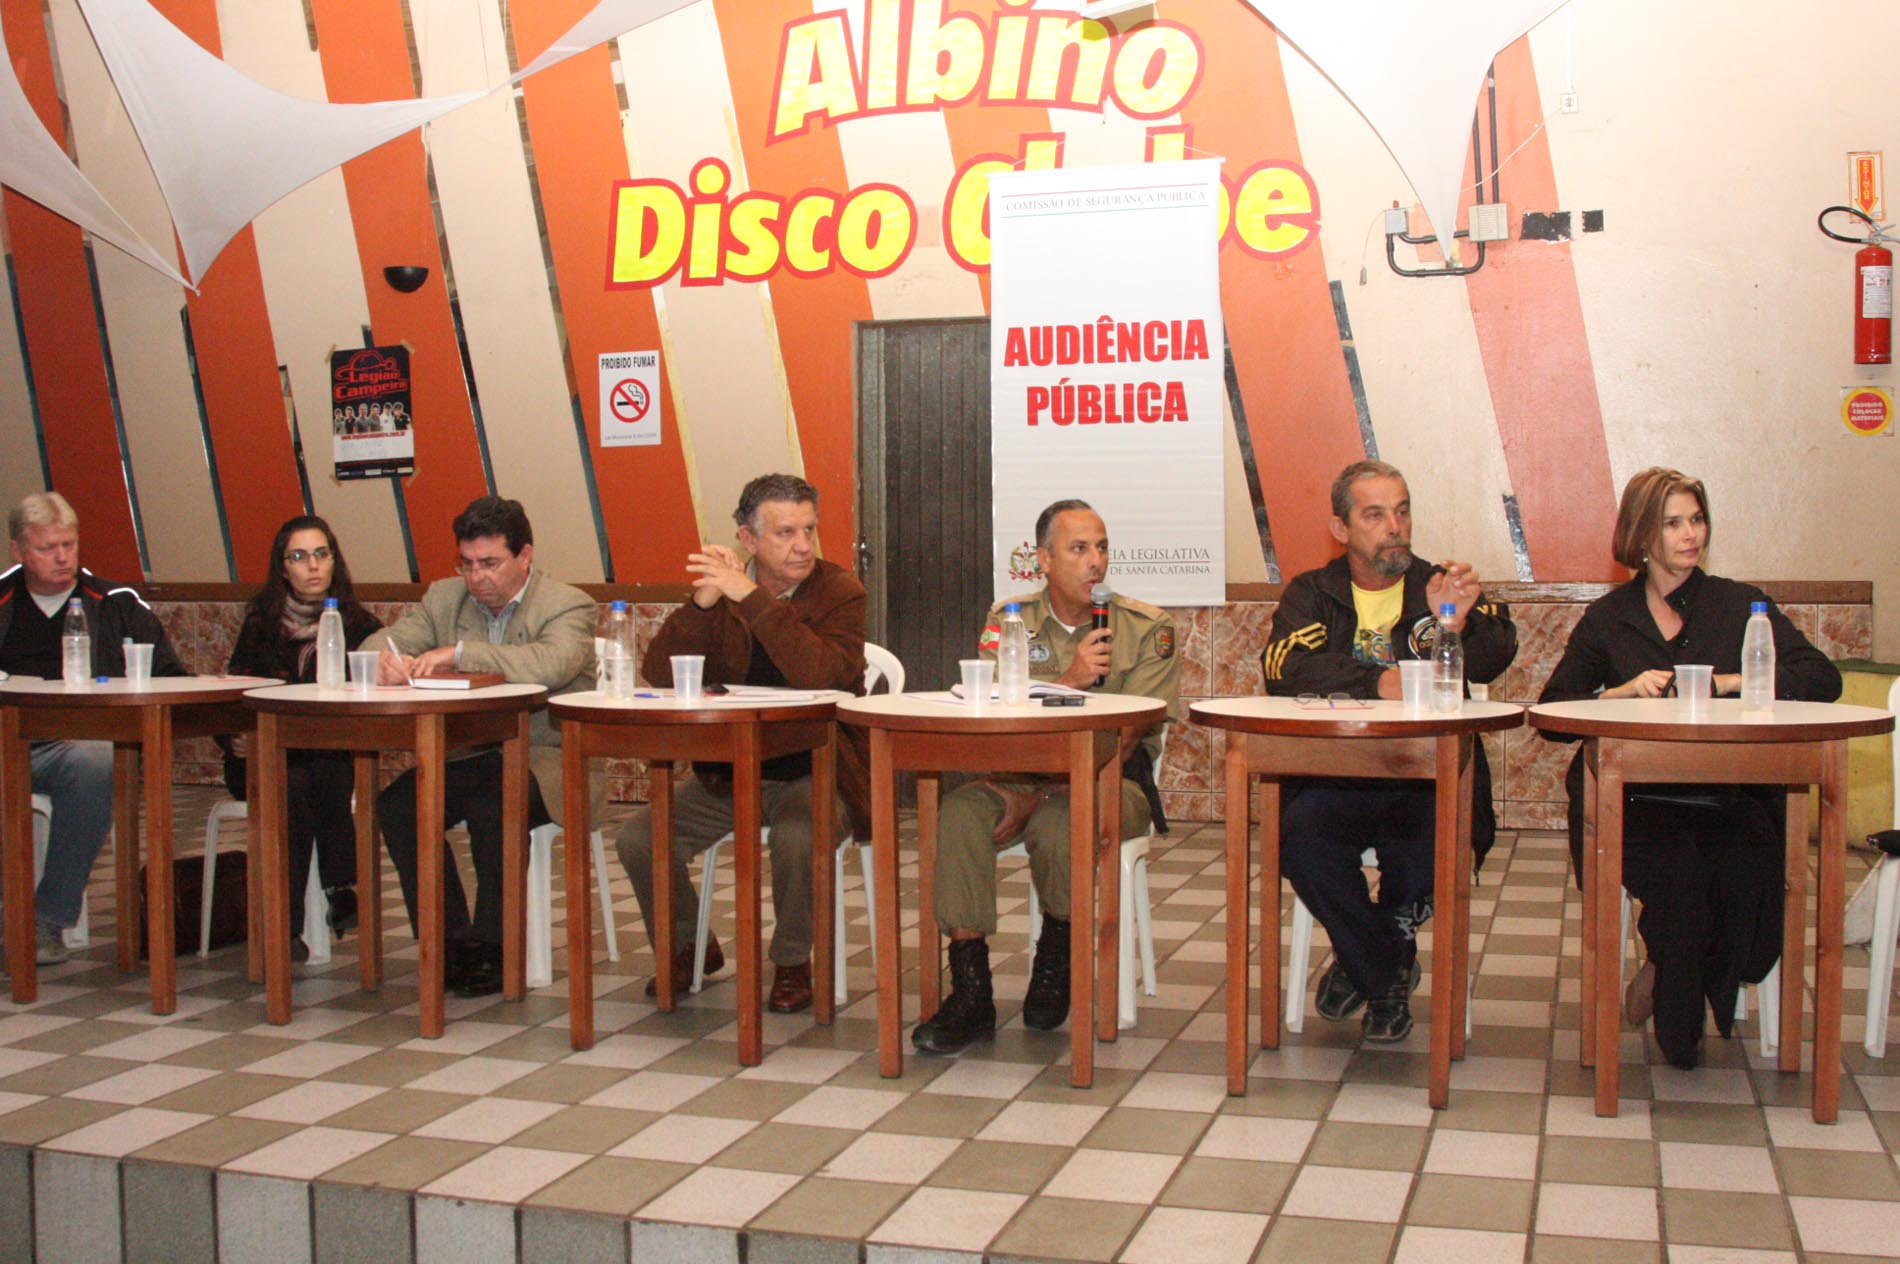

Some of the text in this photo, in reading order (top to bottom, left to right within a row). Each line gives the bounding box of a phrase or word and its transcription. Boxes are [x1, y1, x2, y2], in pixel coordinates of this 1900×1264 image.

[766, 0, 1206, 146] Albino
[1005, 197, 1065, 211] COMISSÃO
[1066, 196, 1083, 208] DE
[1084, 192, 1155, 208] SEGURANÇA
[605, 157, 918, 291] Disco
[1004, 315, 1210, 367] AUDIÊNCIA
[601, 356, 656, 369] PROIBIDO FUMAR
[1026, 377, 1189, 426] PÚBLICA
[1110, 564, 1211, 575] DE SANTA CATARINA
[1131, 548, 1210, 560] LEGISLATIVA
